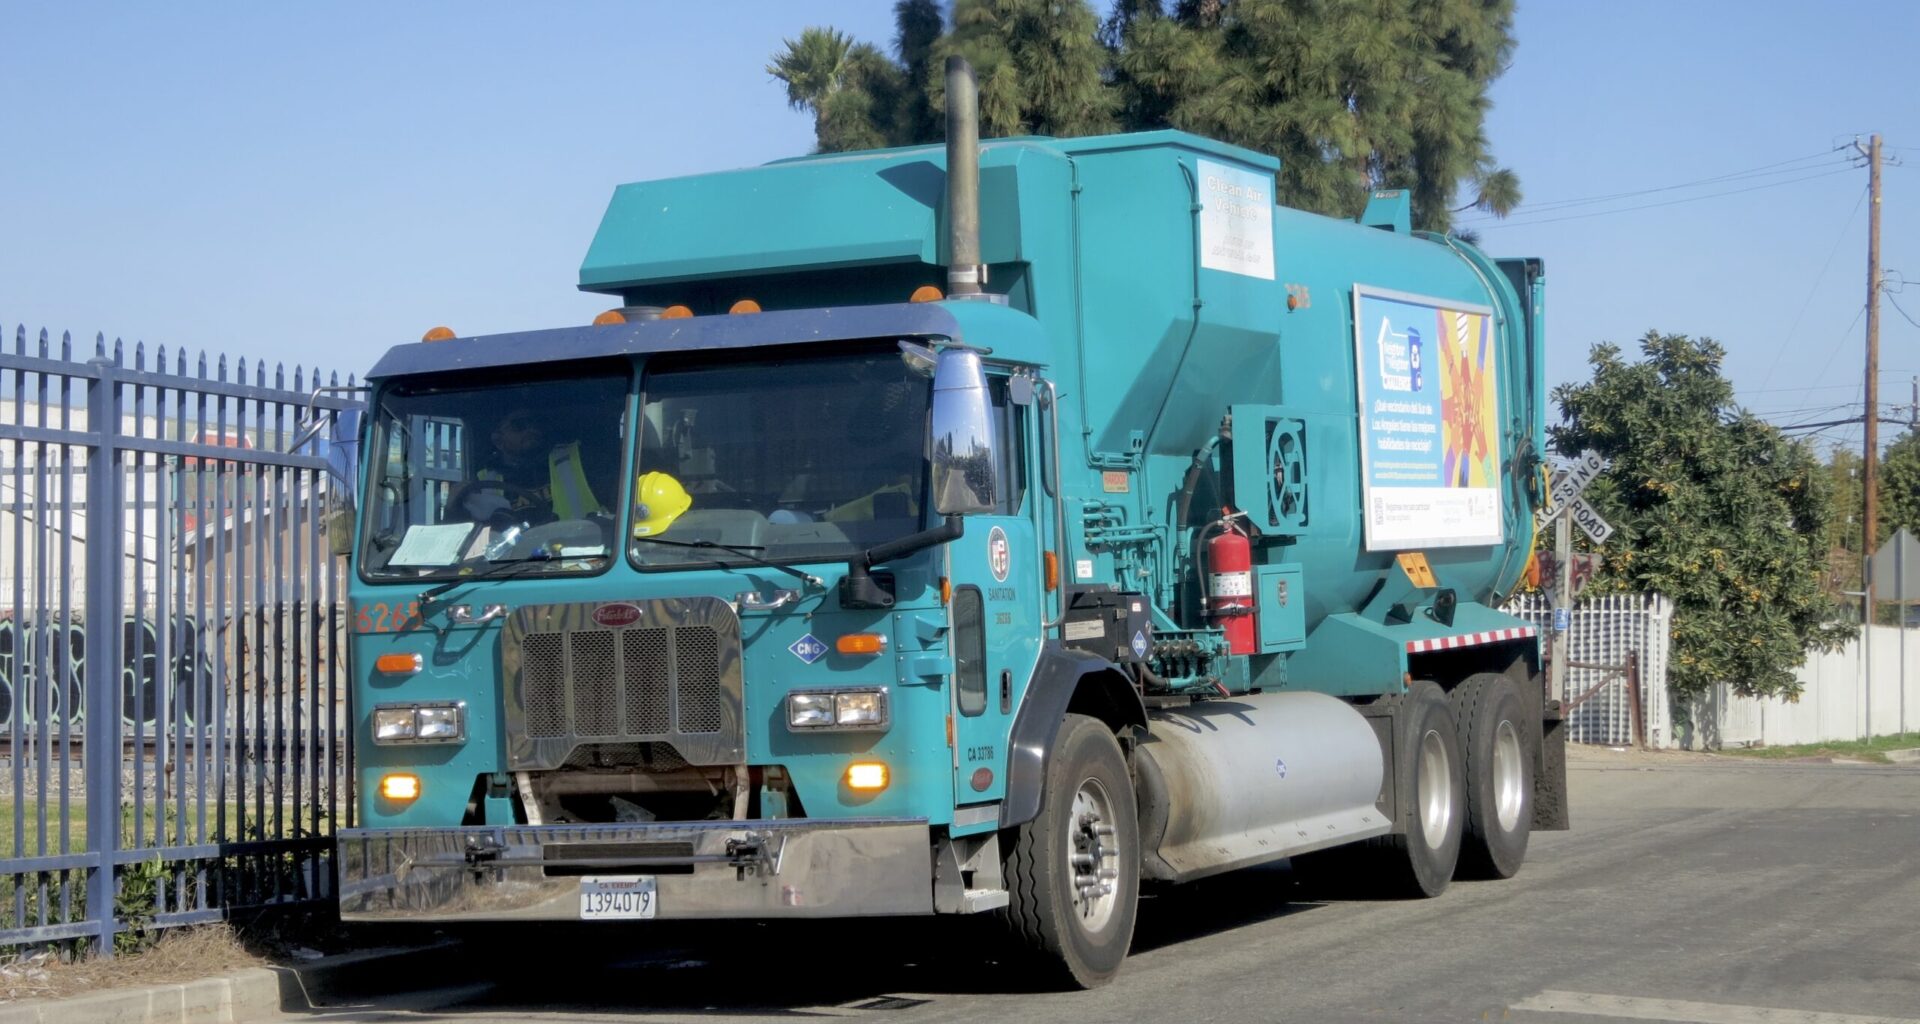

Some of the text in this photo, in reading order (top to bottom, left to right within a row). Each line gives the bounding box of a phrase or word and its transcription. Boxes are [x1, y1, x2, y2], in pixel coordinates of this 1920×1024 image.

[1207, 175, 1264, 202] Clean Air
[1571, 500, 1606, 538] ROAD
[988, 587, 1016, 602] SANITATION
[797, 643, 821, 655] CNG
[967, 747, 977, 761] CA
[585, 891, 650, 912] 1394079
